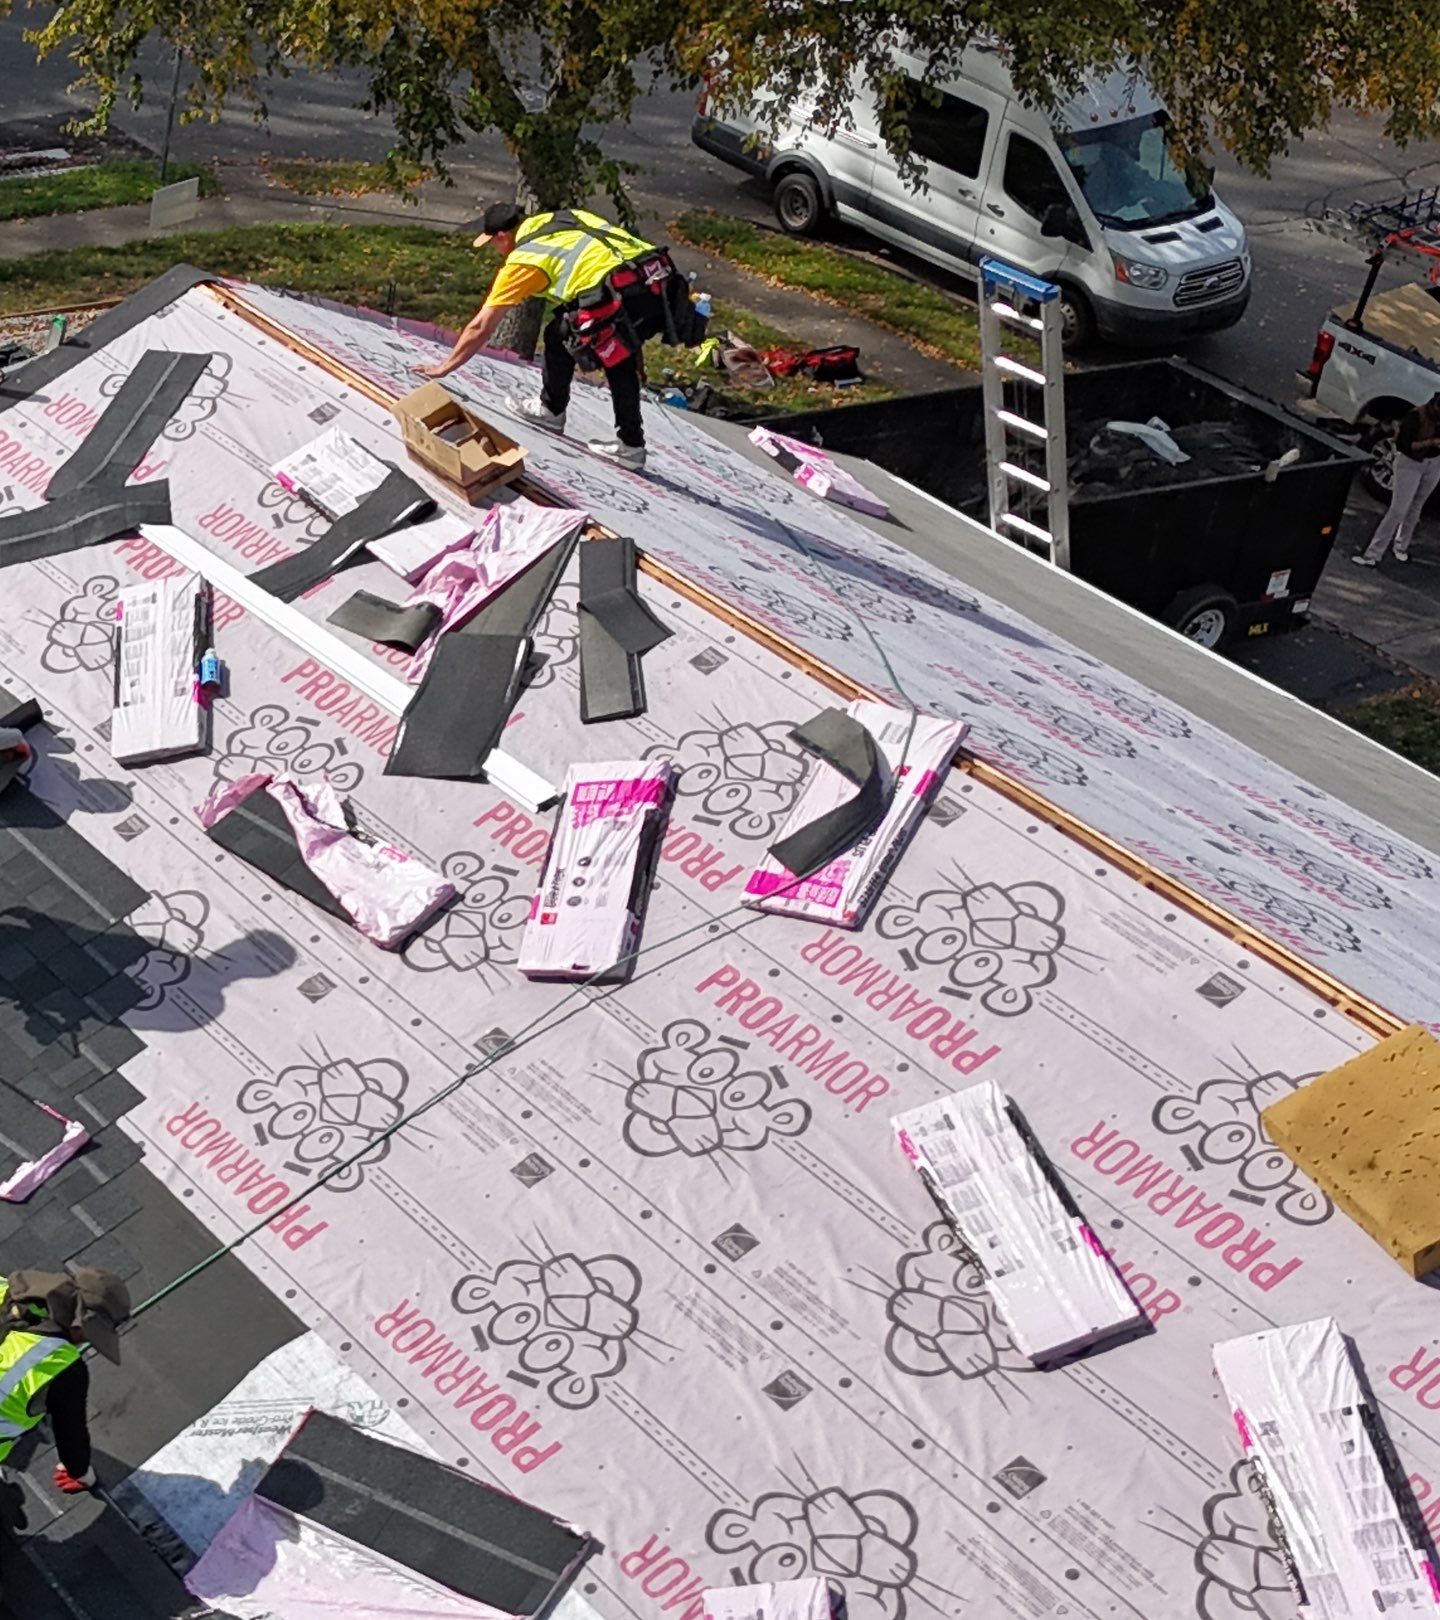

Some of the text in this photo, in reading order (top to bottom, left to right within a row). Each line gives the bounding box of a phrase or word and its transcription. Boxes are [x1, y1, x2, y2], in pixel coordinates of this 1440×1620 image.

[694, 964, 890, 1114] PROARMOR
[799, 929, 1002, 1075] PROARMOR
[166, 1102, 329, 1251] PROARMOR
[1070, 1120, 1304, 1292] PROARMOR
[374, 1298, 563, 1474] PROARMOR
